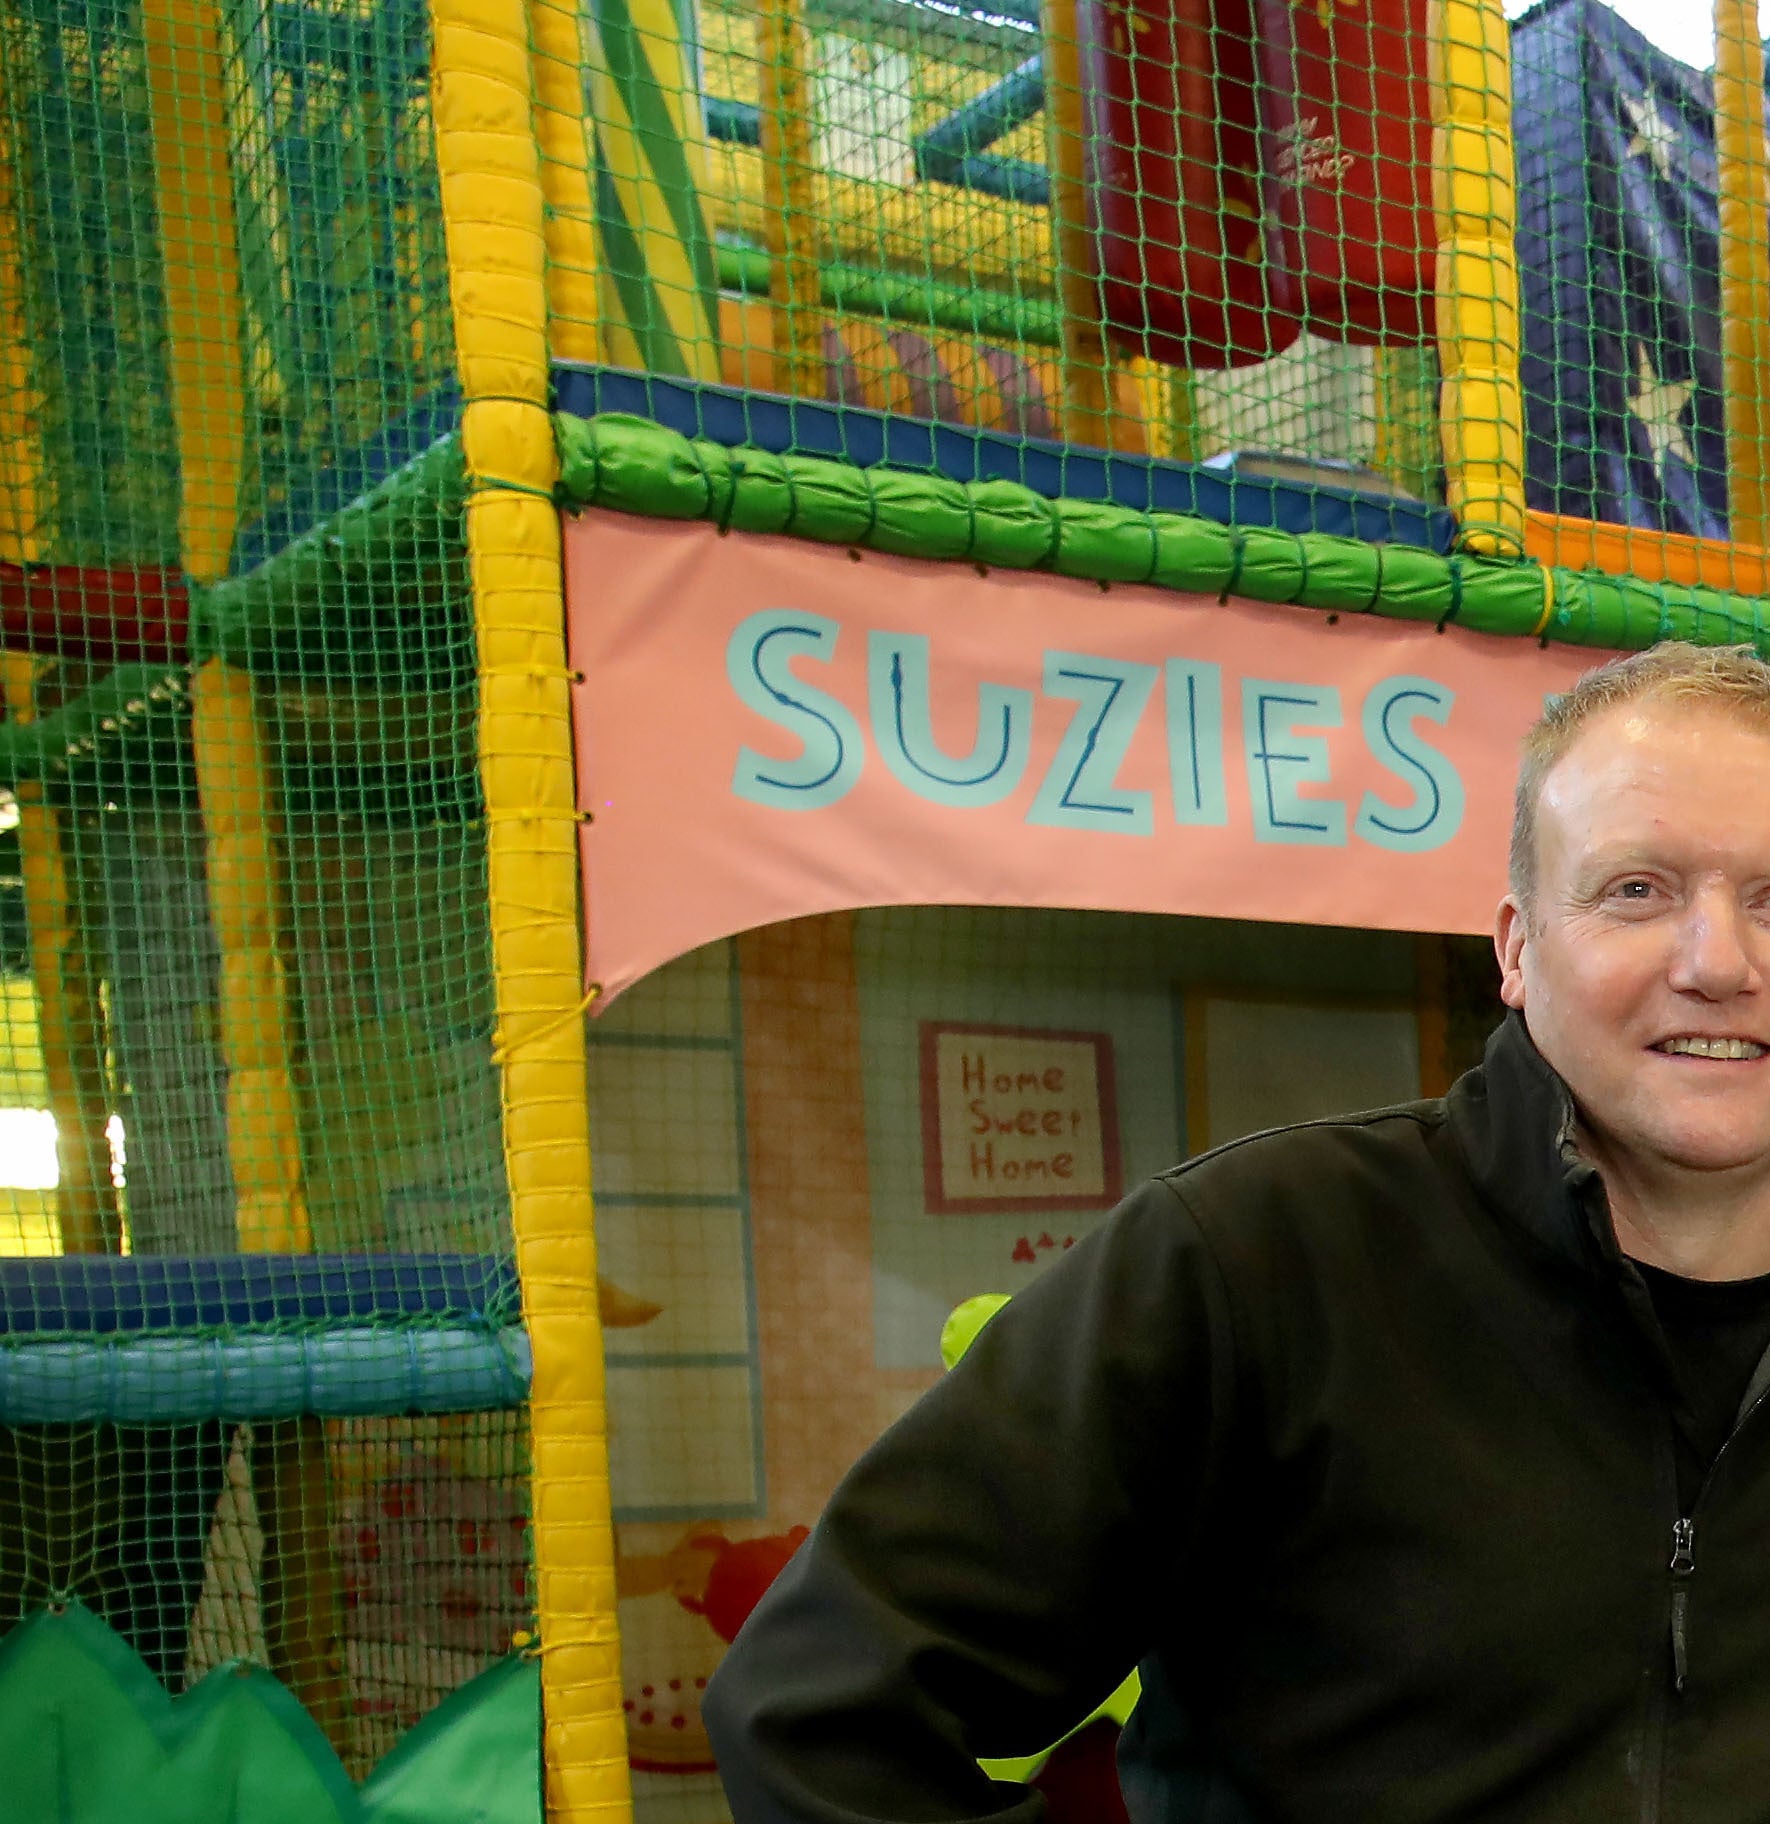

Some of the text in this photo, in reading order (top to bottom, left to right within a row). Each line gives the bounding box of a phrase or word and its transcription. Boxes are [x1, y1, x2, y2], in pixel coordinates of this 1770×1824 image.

[726, 607, 1466, 856] SUZIES
[960, 1053, 1065, 1095] Home
[968, 1098, 1082, 1138] Sweet
[970, 1141, 1074, 1181] Home
